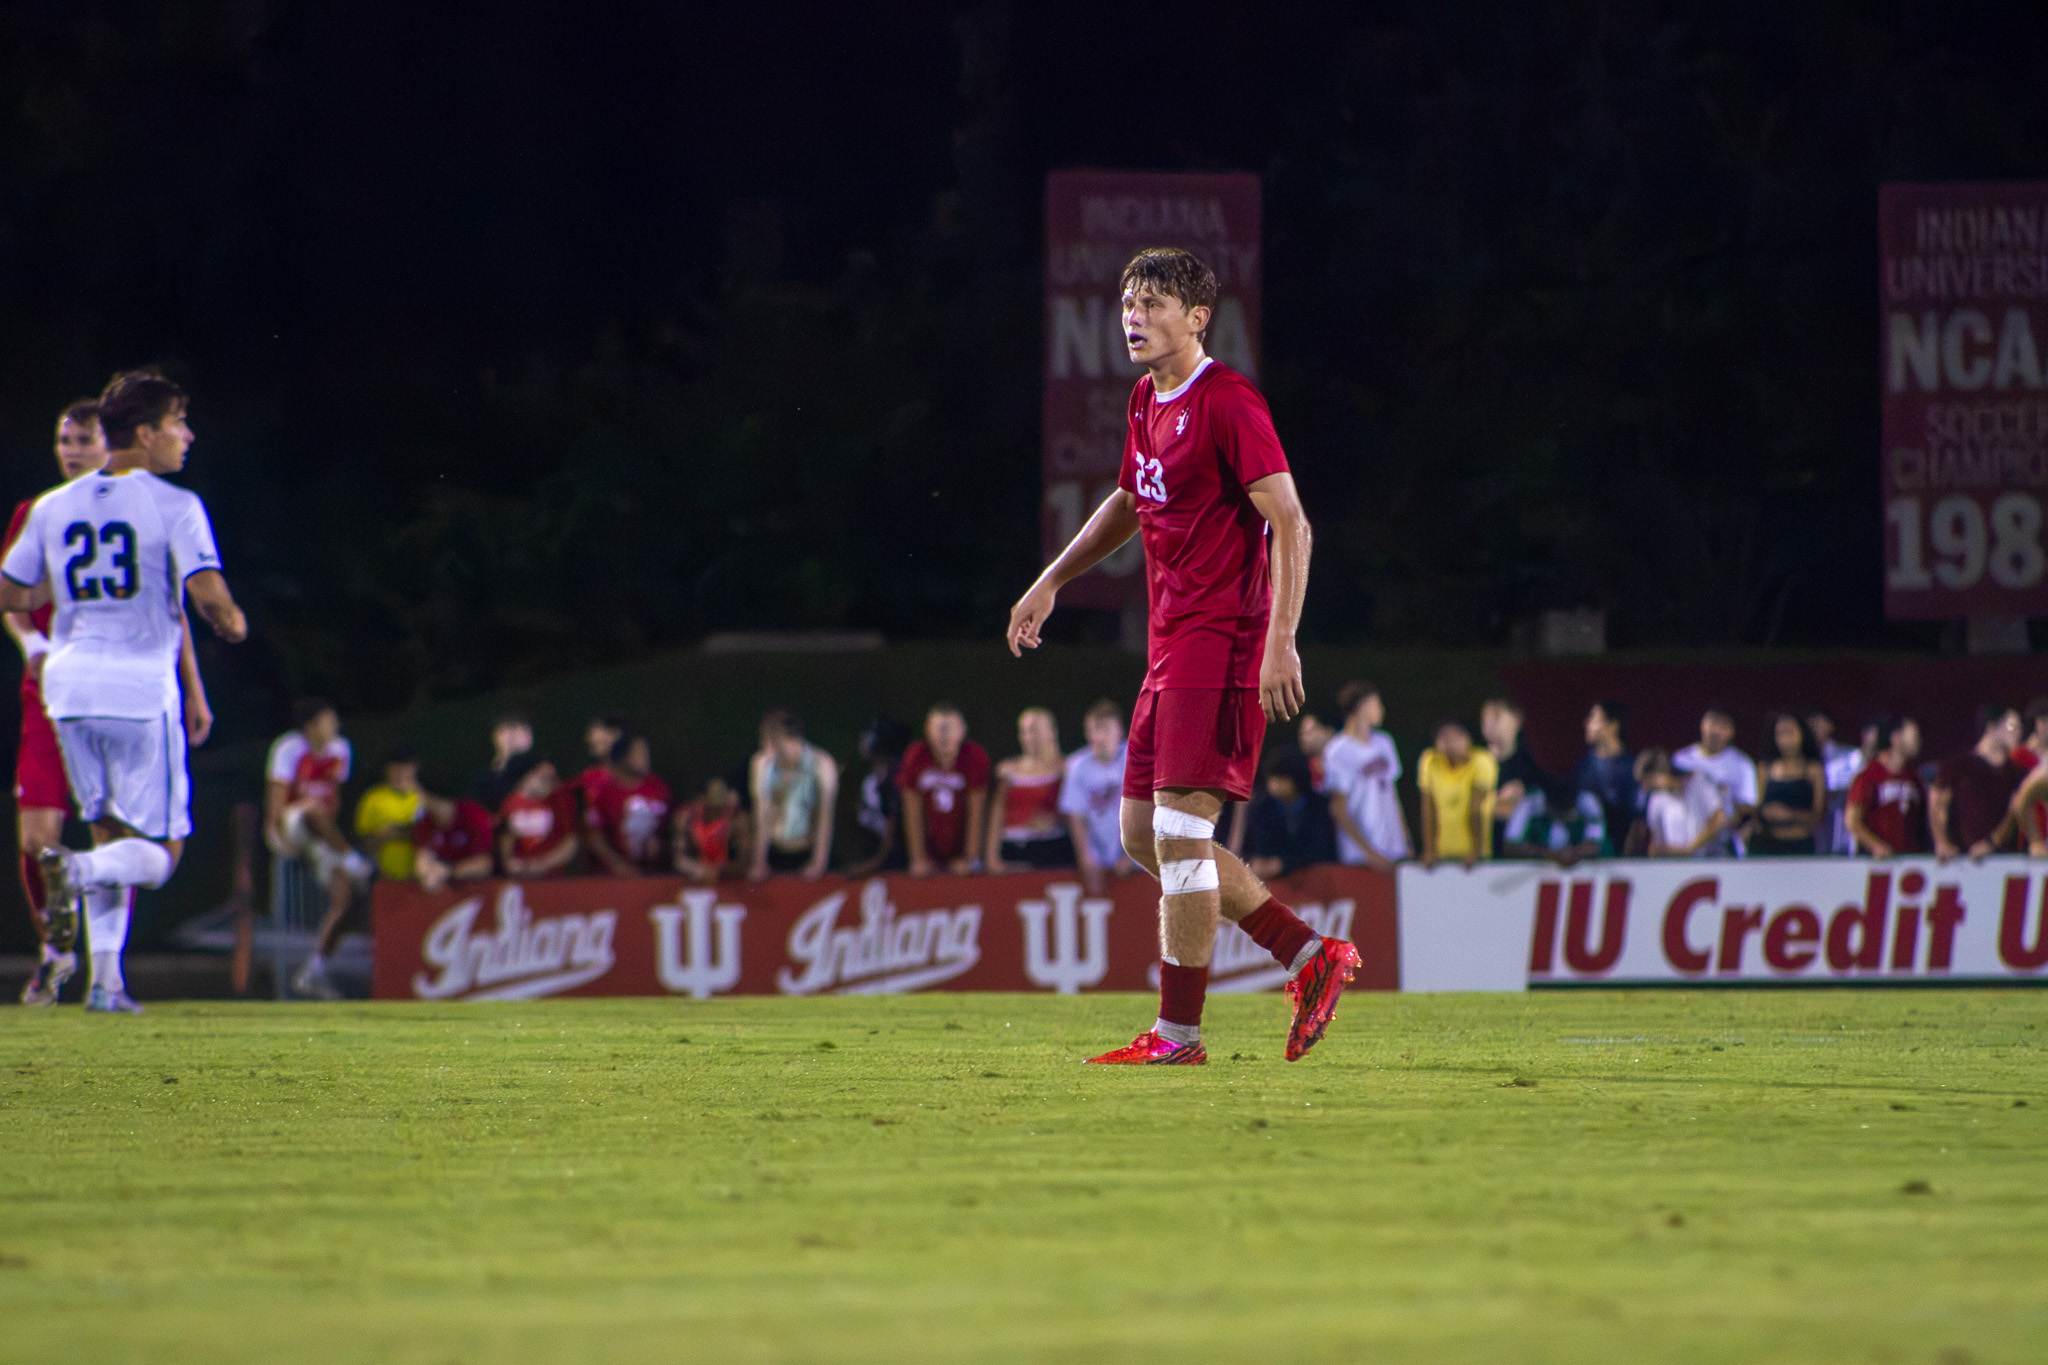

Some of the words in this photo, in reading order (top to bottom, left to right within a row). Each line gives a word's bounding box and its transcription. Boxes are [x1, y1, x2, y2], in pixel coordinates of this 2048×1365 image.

[1916, 207, 2048, 252] INDIAN
[1888, 308, 2048, 393] NCA
[1135, 450, 1168, 503] 23
[65, 521, 138, 600] 23
[1886, 494, 2048, 591] 198
[411, 882, 618, 1000] Indiana
[776, 877, 984, 996] Indiana
[1529, 880, 1632, 975] IU
[1661, 870, 1966, 975] Credit
